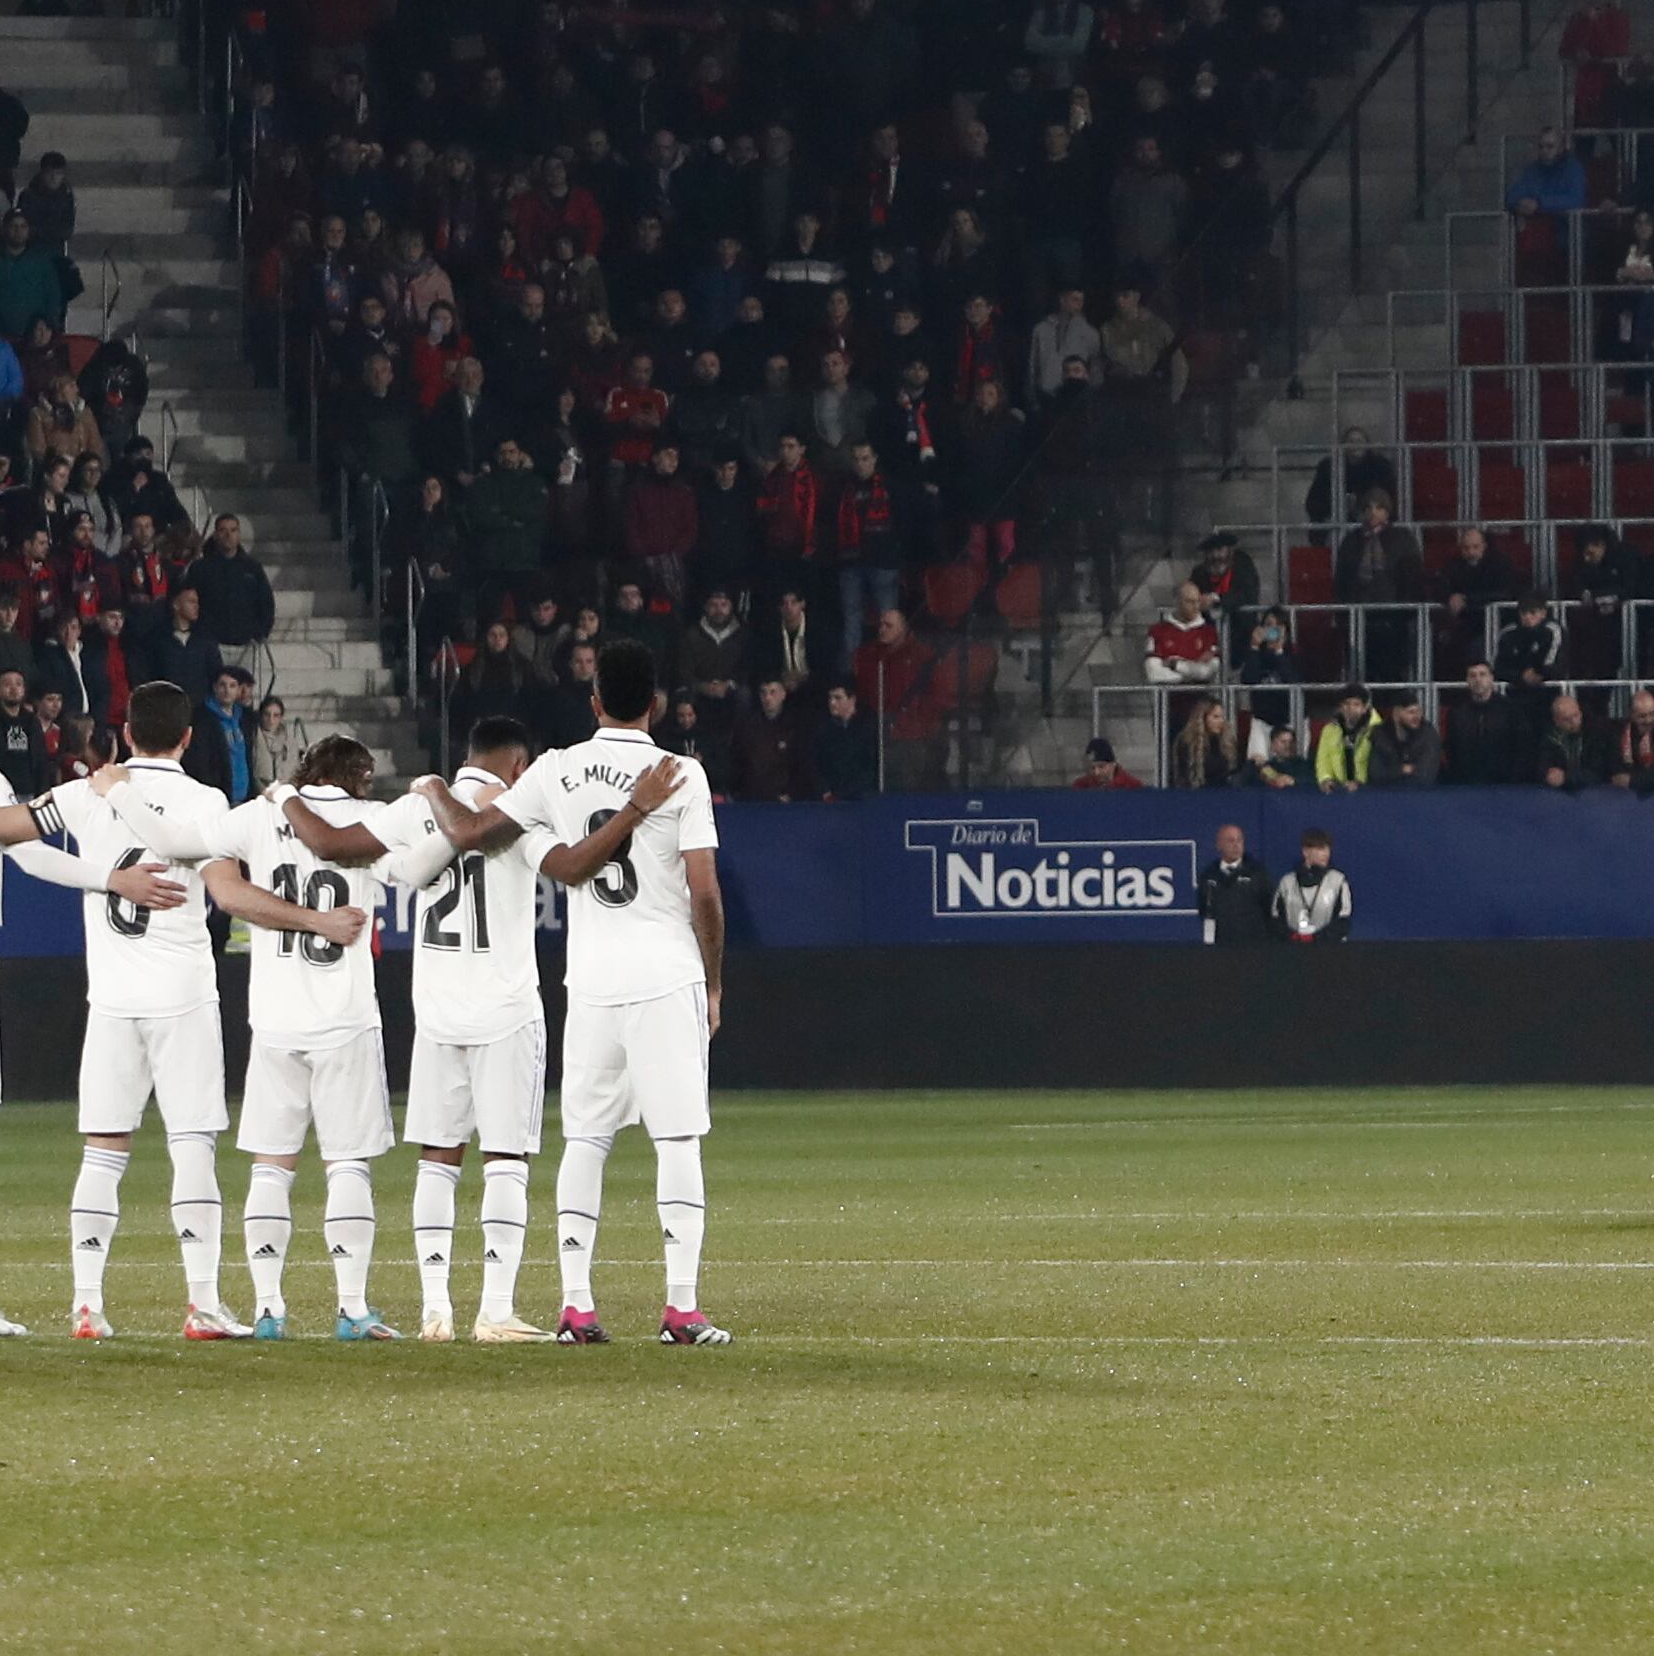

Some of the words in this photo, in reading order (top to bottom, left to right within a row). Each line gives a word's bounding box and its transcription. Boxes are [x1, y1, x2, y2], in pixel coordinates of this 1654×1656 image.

[951, 824, 1007, 845] Diario
[1011, 823, 1032, 844] de
[422, 852, 491, 953] 21
[946, 849, 1175, 908] Noticias
